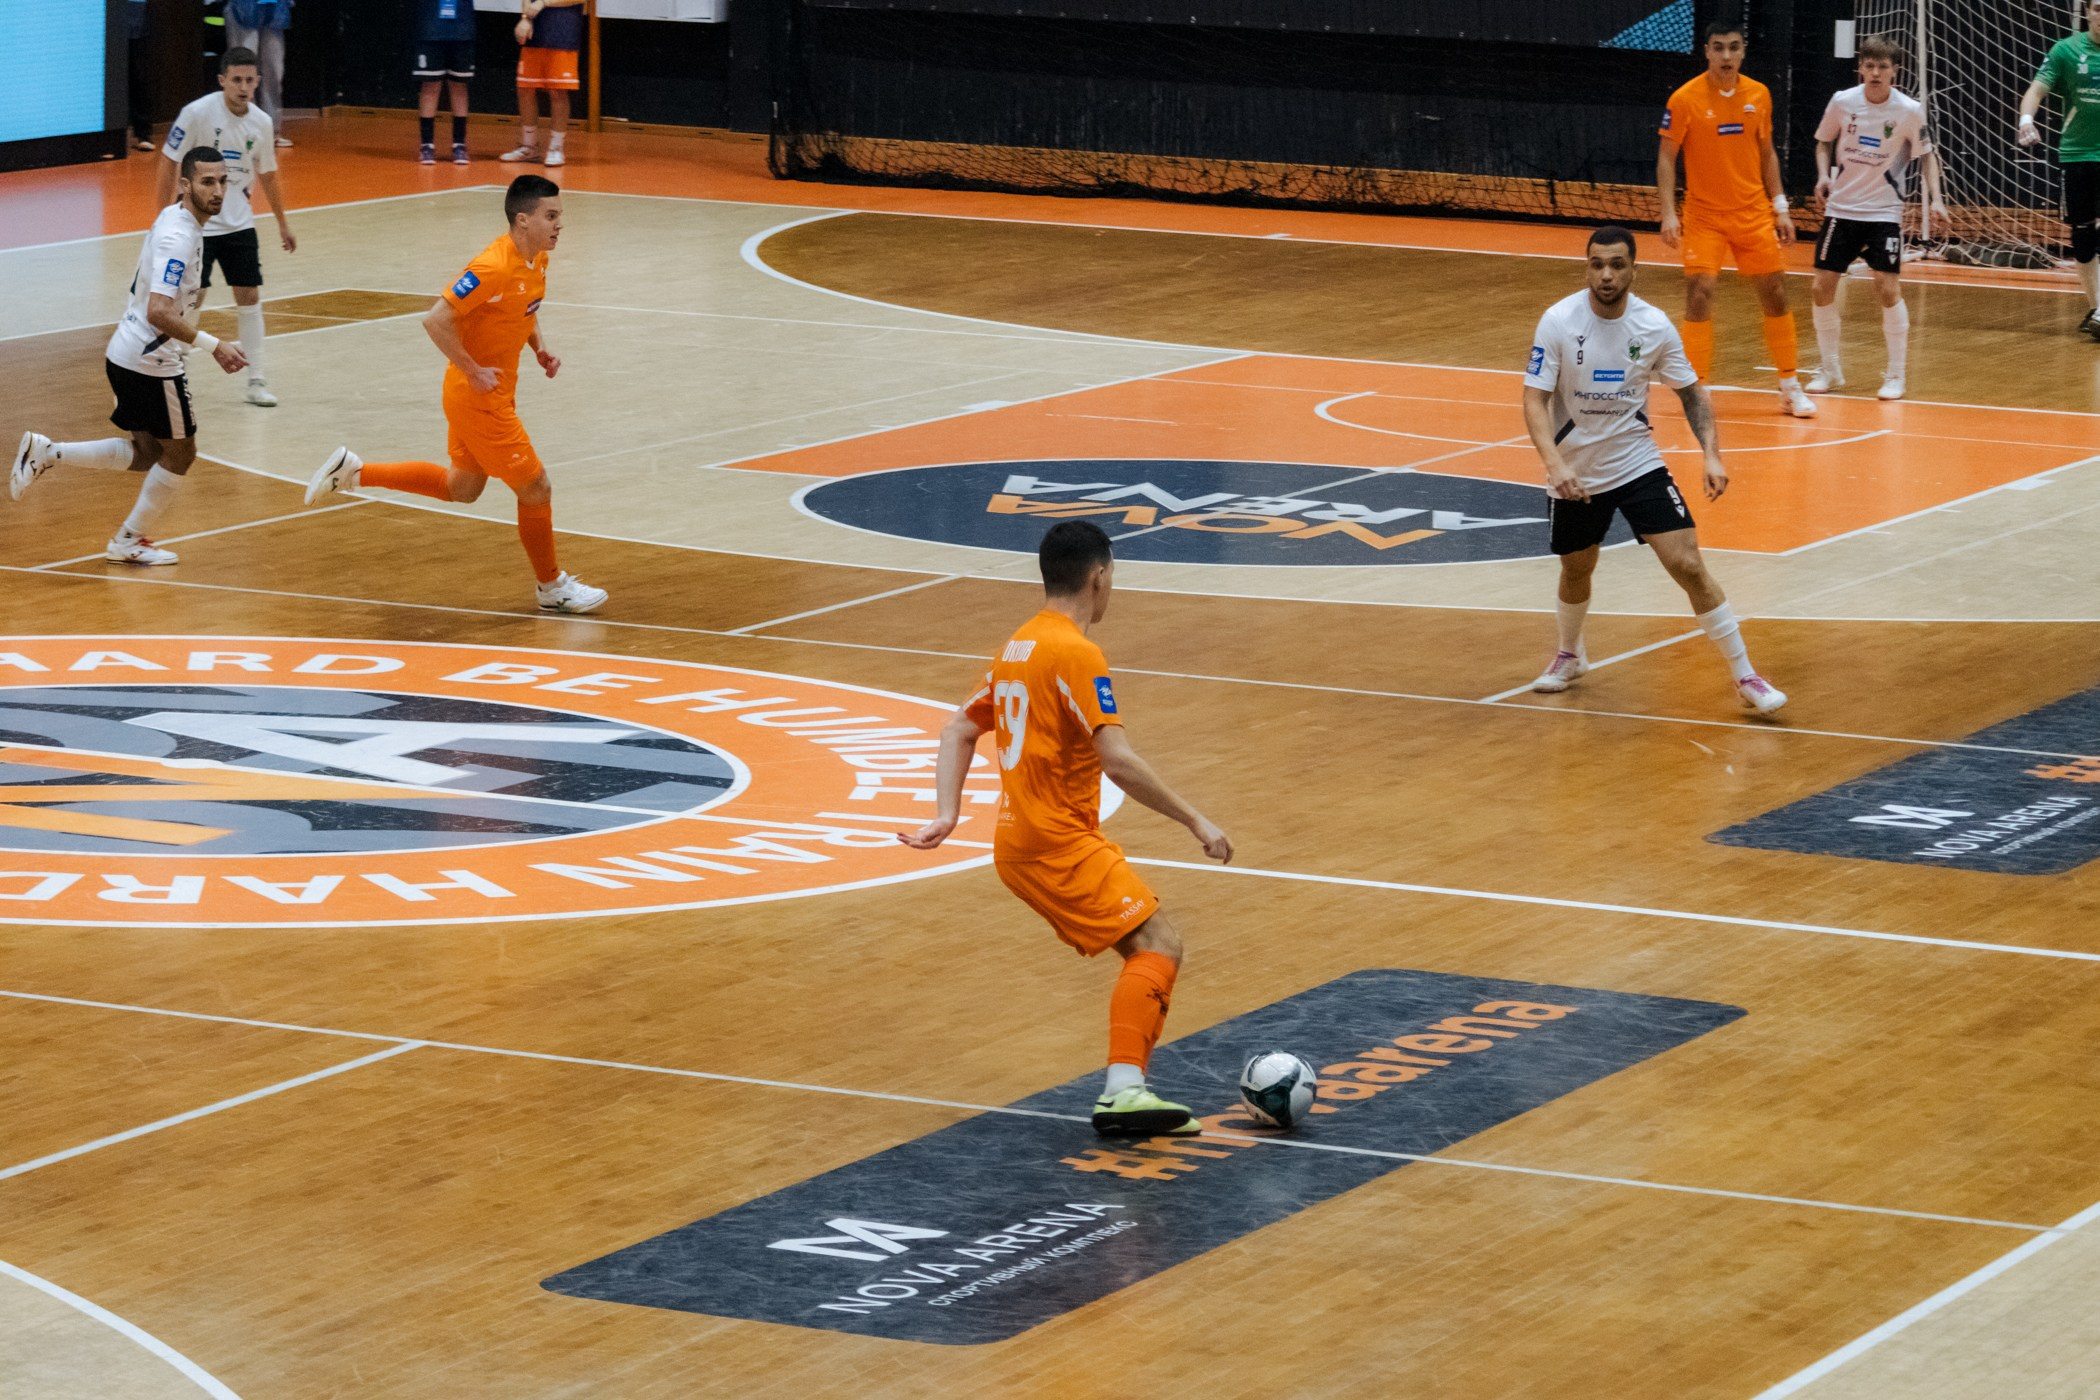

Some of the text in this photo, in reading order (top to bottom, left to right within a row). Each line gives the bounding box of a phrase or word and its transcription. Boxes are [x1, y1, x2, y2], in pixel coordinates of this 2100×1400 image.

[1576, 350, 1584, 365] 9
[986, 493, 1447, 550] NOVA
[1002, 474, 1551, 531] ARENA
[440, 662, 663, 696] BE
[636, 687, 1001, 806] HUMBLE
[528, 811, 974, 889] TRAIN
[1913, 796, 2093, 859] NOVA ARENA
[1119, 898, 1146, 921] TASSAY
[818, 1202, 1126, 1315] NOVA ARENA
[928, 1219, 1139, 1307] СПОРТИВНЫЙ КОМПЛЕКС
